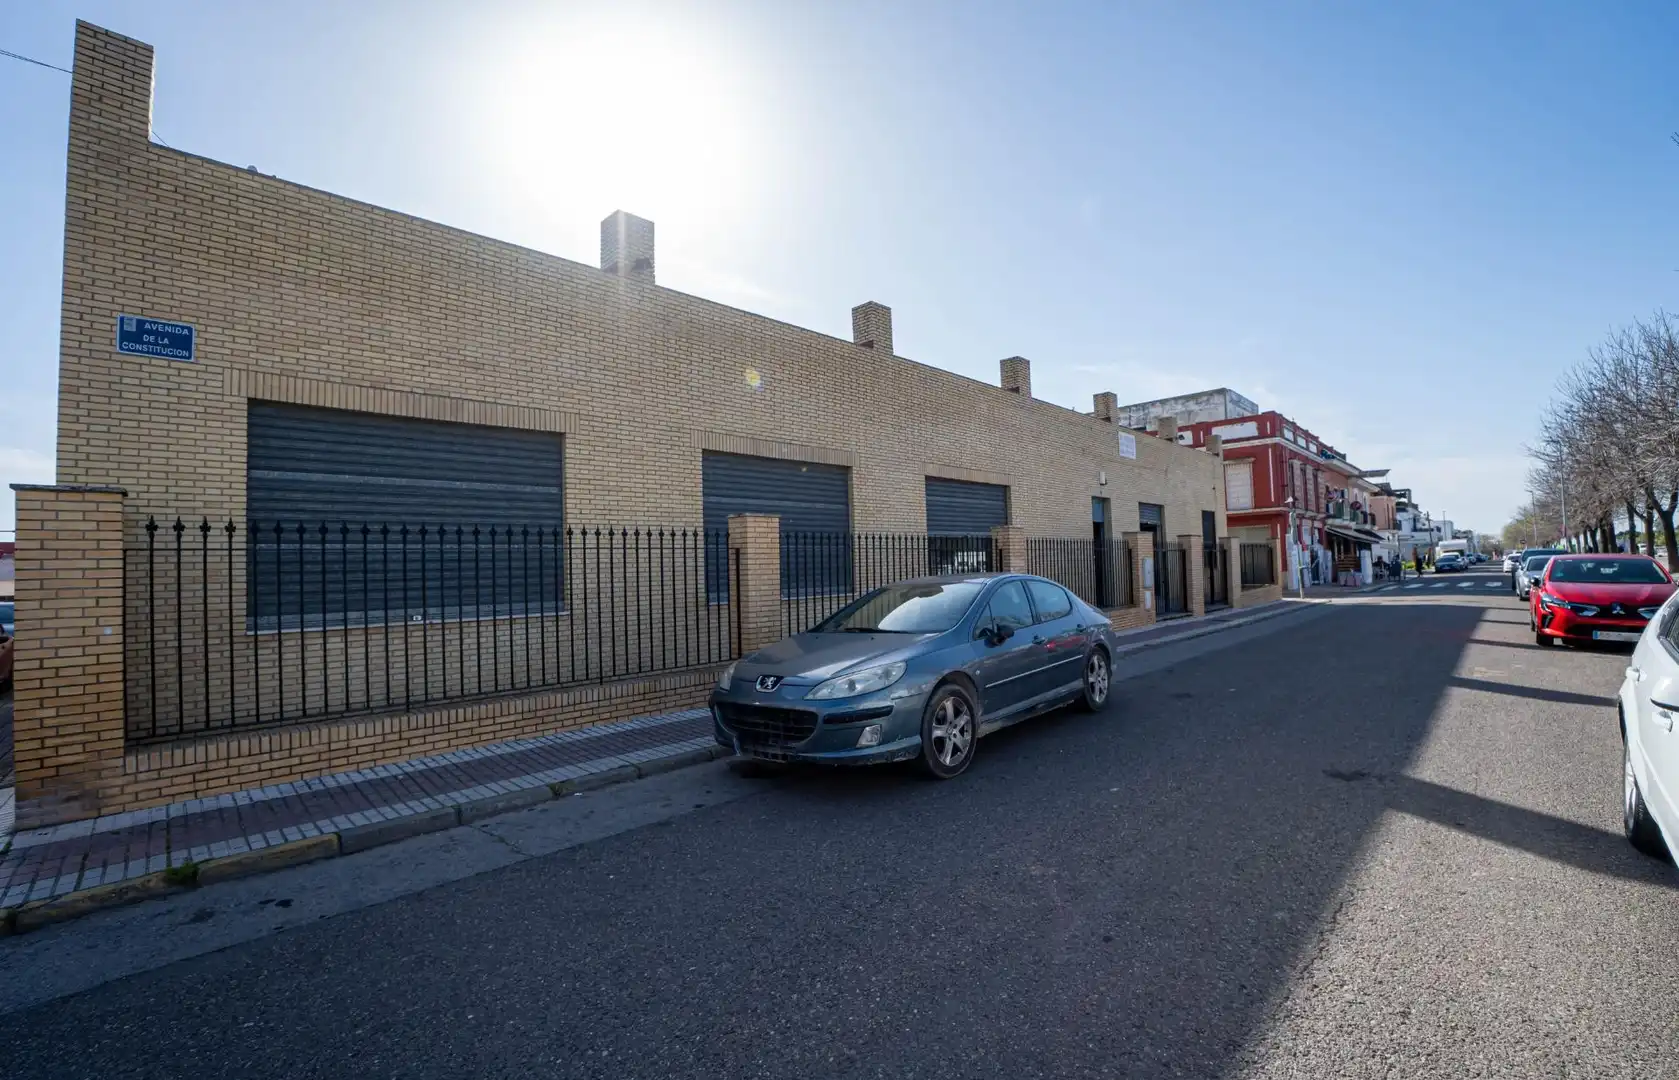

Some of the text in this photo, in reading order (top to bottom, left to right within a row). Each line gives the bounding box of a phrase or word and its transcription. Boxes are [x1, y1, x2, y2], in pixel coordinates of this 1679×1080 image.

[144, 322, 189, 335] AVENIDA
[143, 334, 155, 342] DE
[122, 342, 188, 357] CONSTITUCION
